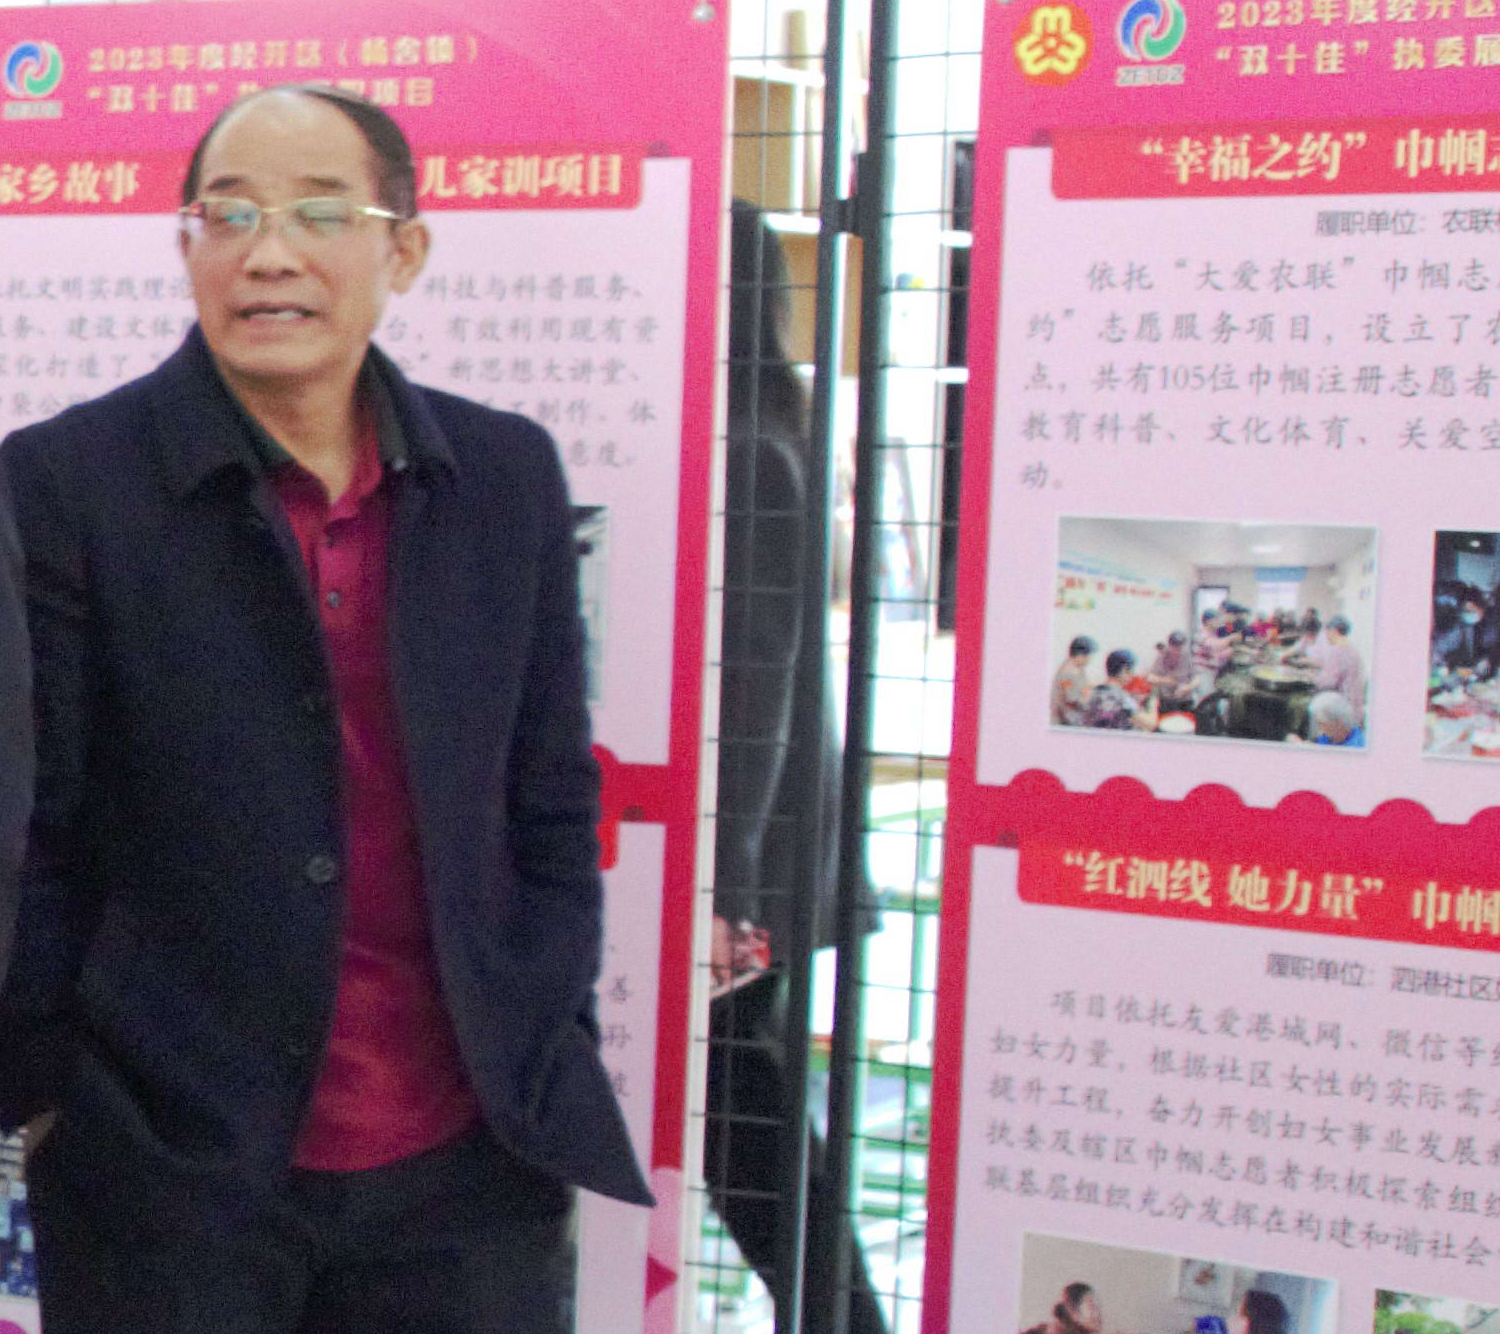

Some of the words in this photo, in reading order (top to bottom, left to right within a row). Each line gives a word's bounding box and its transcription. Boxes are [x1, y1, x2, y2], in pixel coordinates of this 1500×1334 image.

[1141, 128, 1500, 185] “幸福之约”巾帼
[1086, 255, 1500, 295] 依托“大爱农联”巾帼志
[1265, 953, 1500, 1003] 履职单位：泗港社区
[1050, 989, 1500, 1069] 项目依托友爱港城网、微信等
